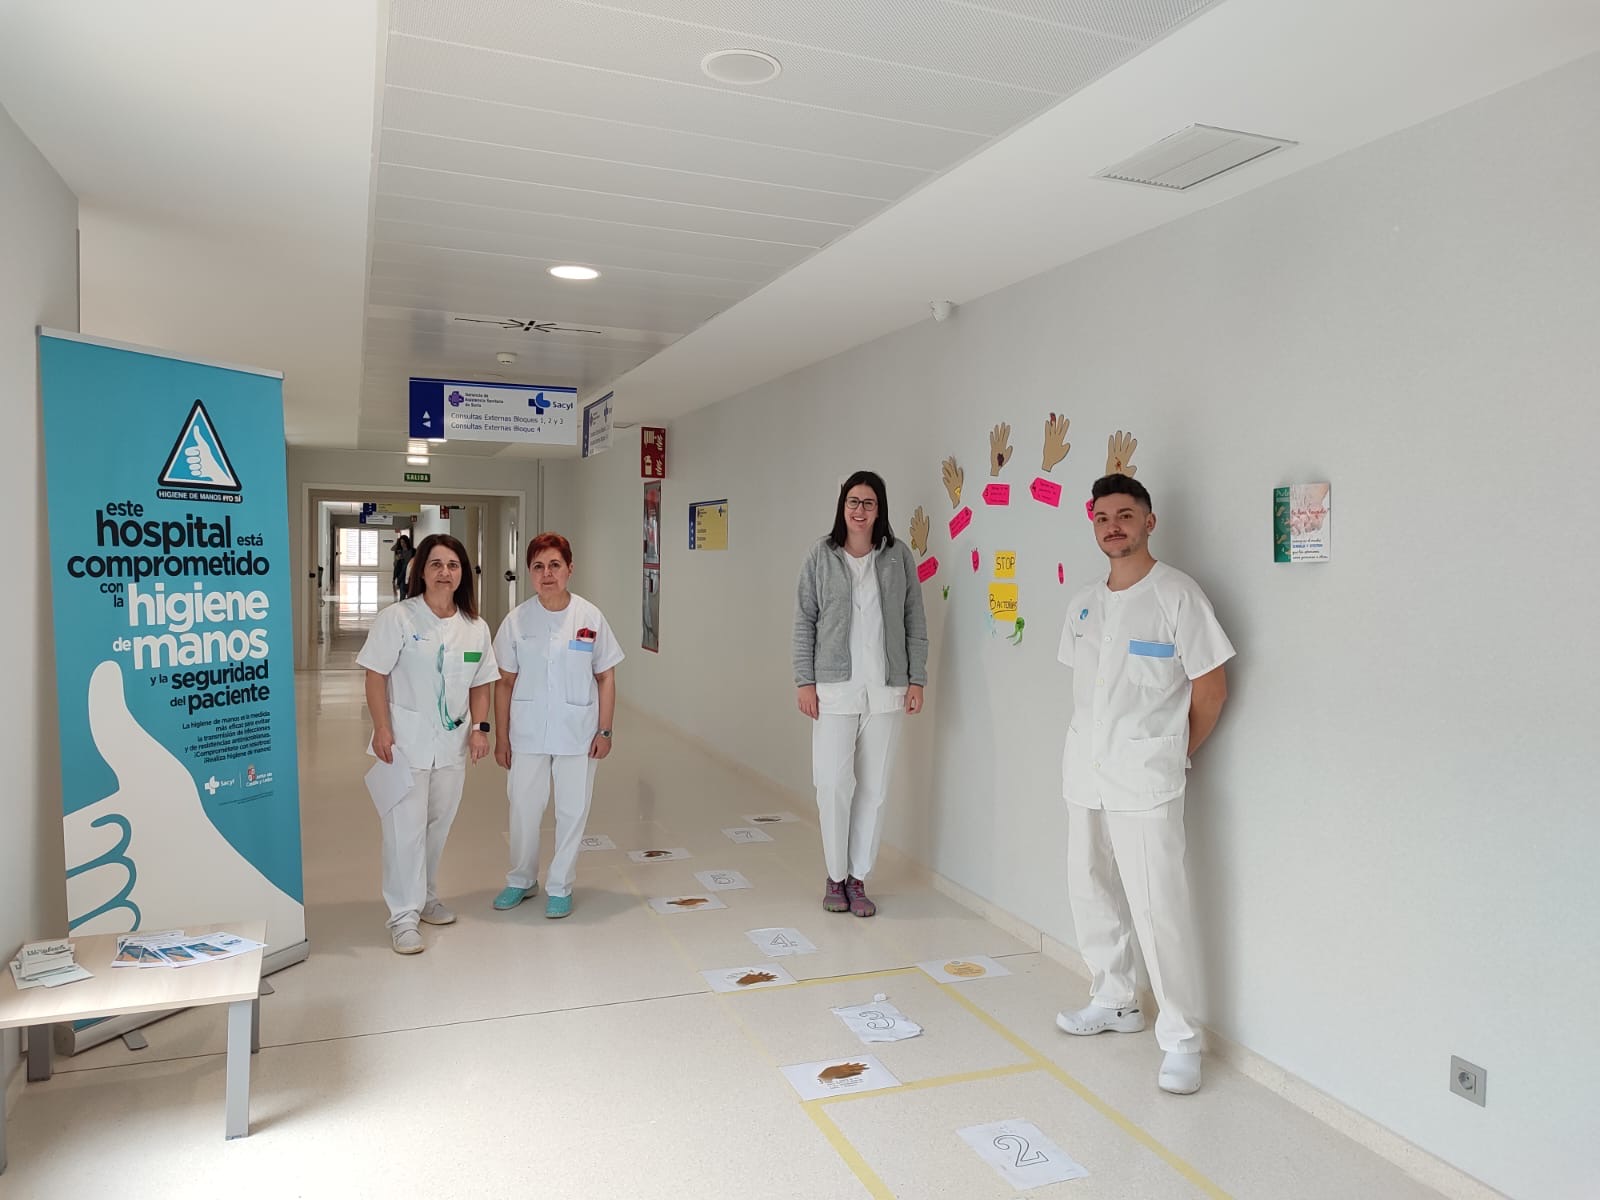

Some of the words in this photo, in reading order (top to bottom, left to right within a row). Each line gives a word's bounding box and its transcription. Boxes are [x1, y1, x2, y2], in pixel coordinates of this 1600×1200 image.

[552, 401, 574, 410] Sacyl
[451, 412, 482, 420] Consultas
[484, 414, 512, 422] Externas
[514, 416, 538, 424] Bloques
[451, 422, 482, 430] Consultas
[484, 424, 512, 432] Externas
[514, 424, 535, 434] Bloque
[158, 490, 188, 499] HIGIENE
[200, 493, 222, 501] MANOS
[106, 500, 144, 517] este
[96, 510, 232, 554] hospital
[237, 532, 264, 546] está
[67, 550, 270, 582] comprometido
[996, 556, 1016, 570] STOP
[100, 582, 124, 594] con
[114, 595, 124, 608] la
[128, 582, 270, 632] higiene
[112, 638, 132, 652] de
[132, 628, 269, 670] manos
[150, 676, 156, 686] y
[159, 674, 168, 684] la
[171, 660, 269, 690] seguridad
[170, 696, 186, 708] del
[188, 683, 270, 715] paciente
[190, 720, 212, 728] higiene
[204, 731, 236, 741] transmisión
[198, 740, 231, 750] resistencias
[226, 752, 246, 760] higiene
[734, 830, 752, 840] 7
[710, 873, 734, 886] 5
[770, 932, 799, 948] 4
[858, 1010, 896, 1030] 3
[993, 1134, 1049, 1168] 2
